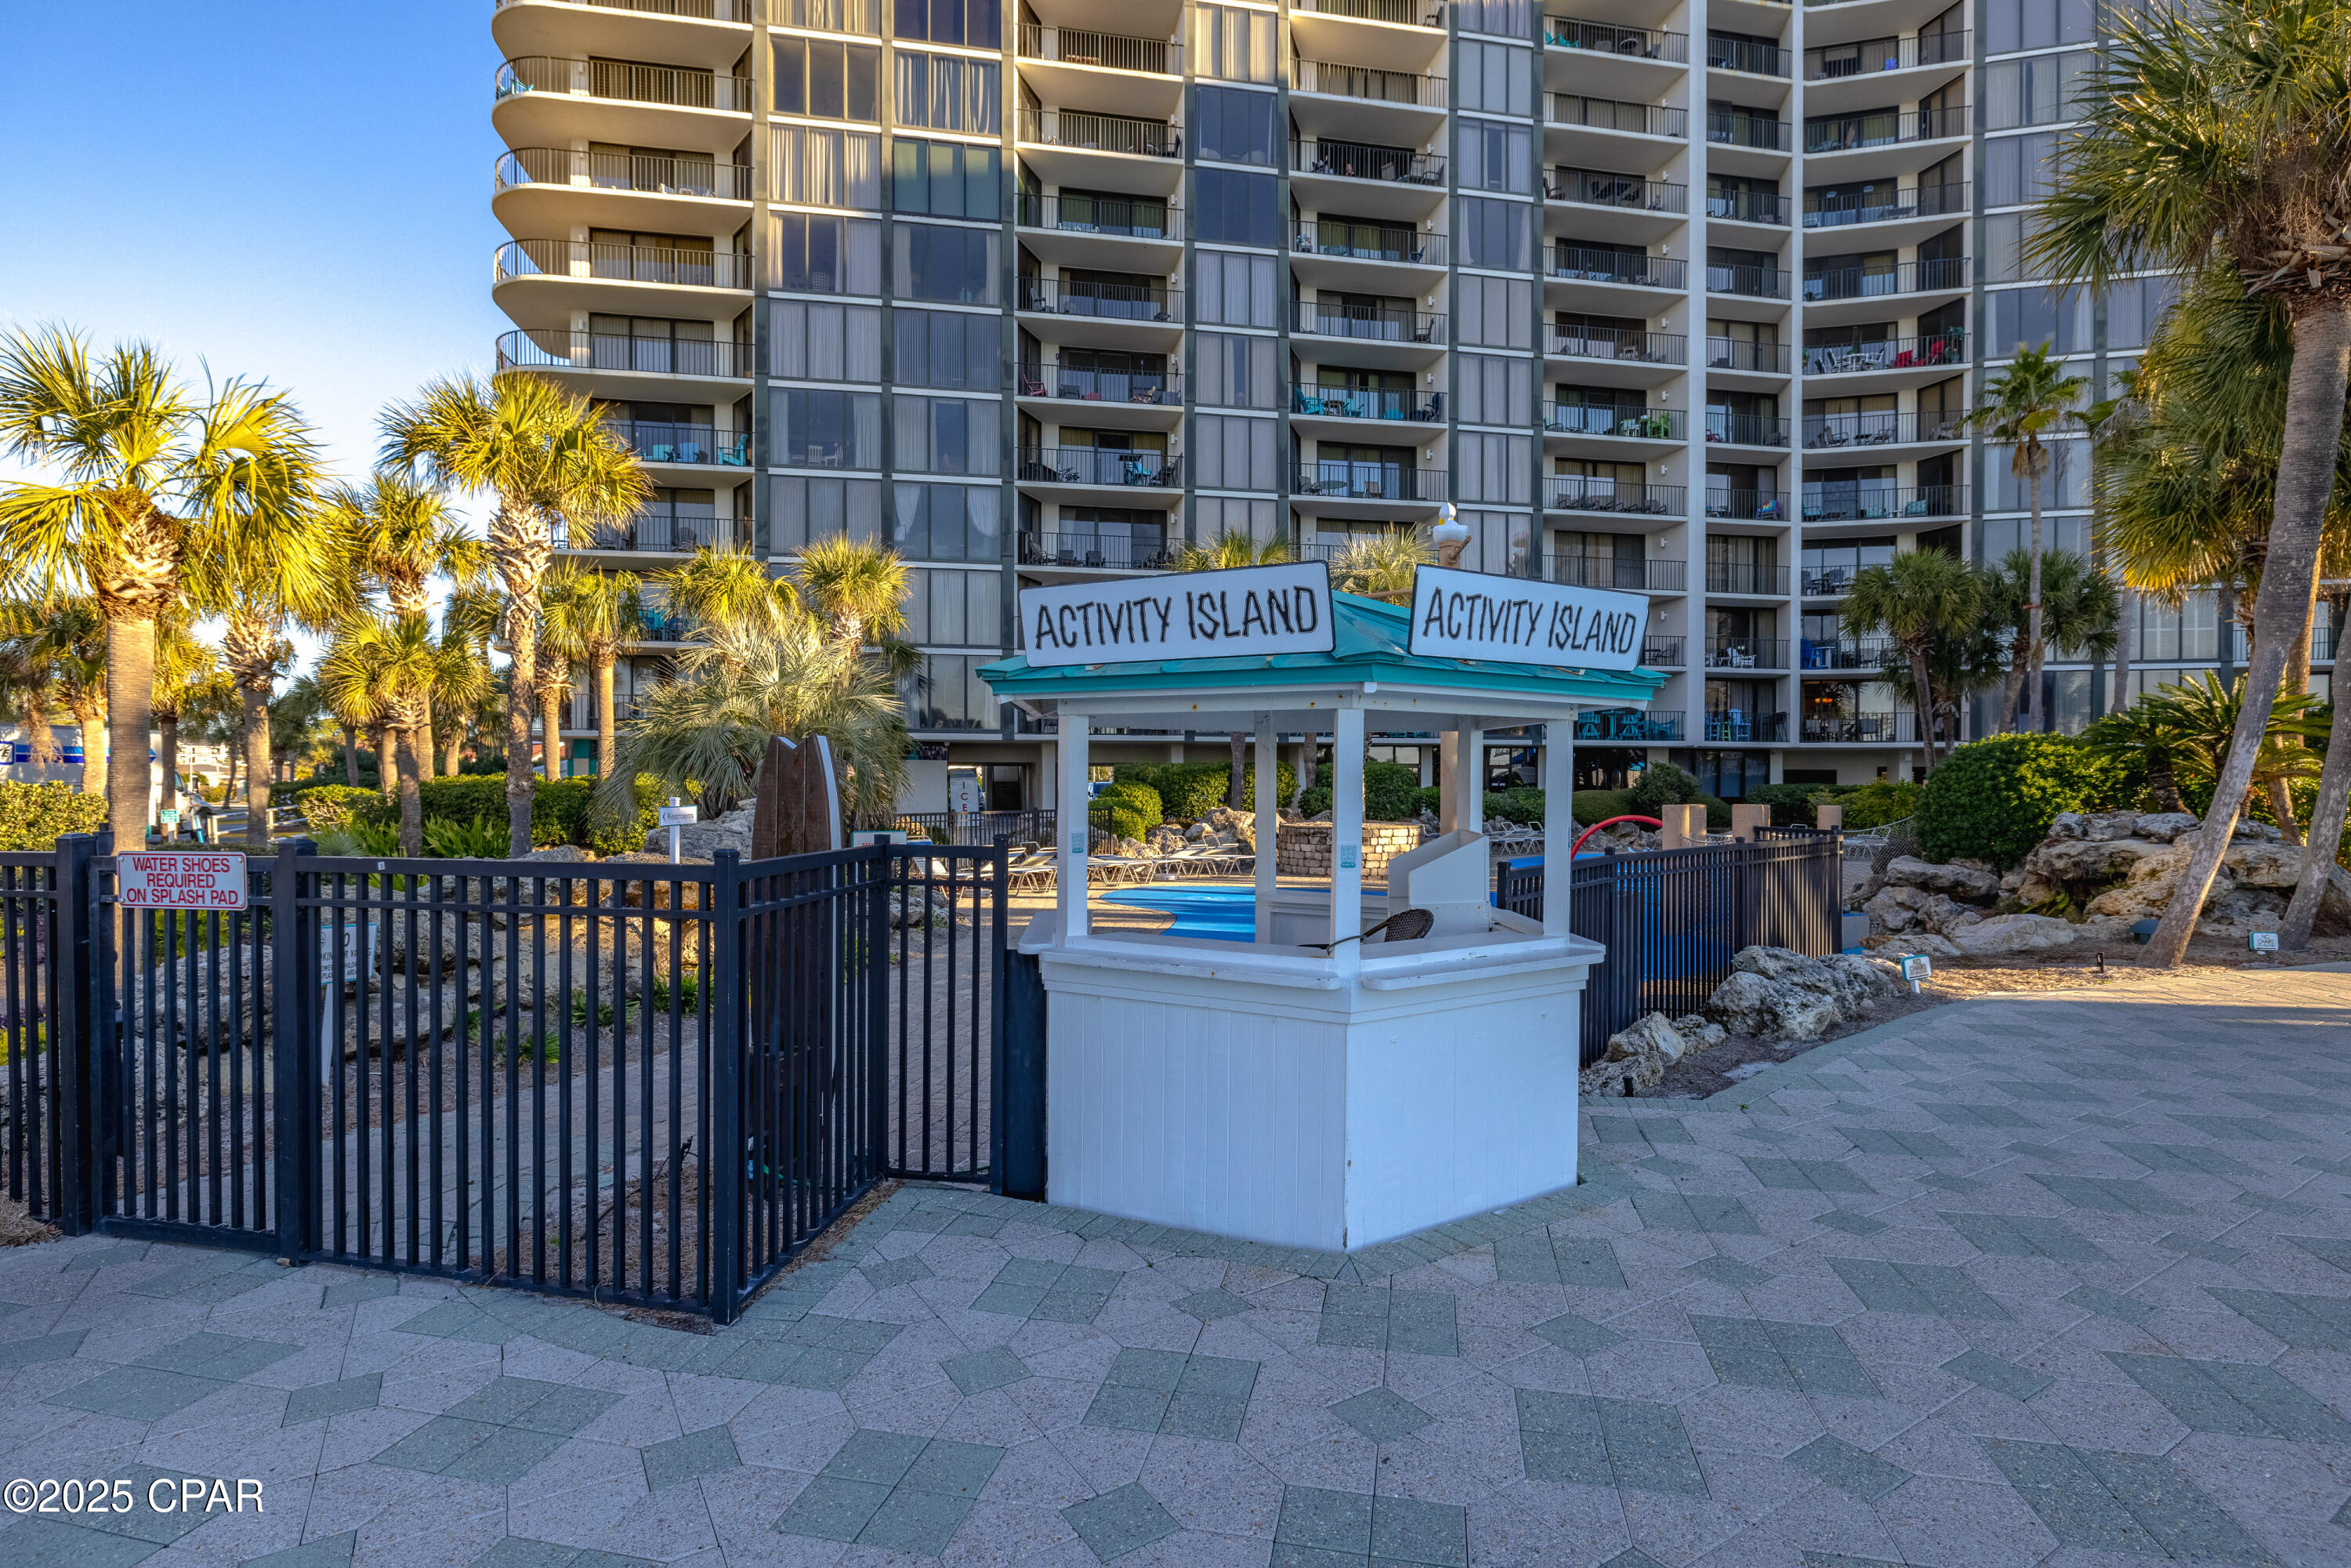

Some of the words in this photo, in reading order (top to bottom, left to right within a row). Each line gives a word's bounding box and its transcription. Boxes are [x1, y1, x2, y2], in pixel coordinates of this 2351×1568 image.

[1035, 596, 1172, 650] ACTIVITY
[1186, 585, 1318, 641] ISLAND
[1422, 587, 1543, 646] ACTIVITY
[1548, 600, 1636, 654] ISLAND
[960, 780, 969, 812] ICE
[132, 857, 177, 871] WATER
[183, 858, 230, 873] SHOES
[147, 873, 216, 889] REQUIRED
[126, 888, 147, 903] ON
[151, 889, 205, 904] SPLASH
[210, 890, 238, 905] PAD
